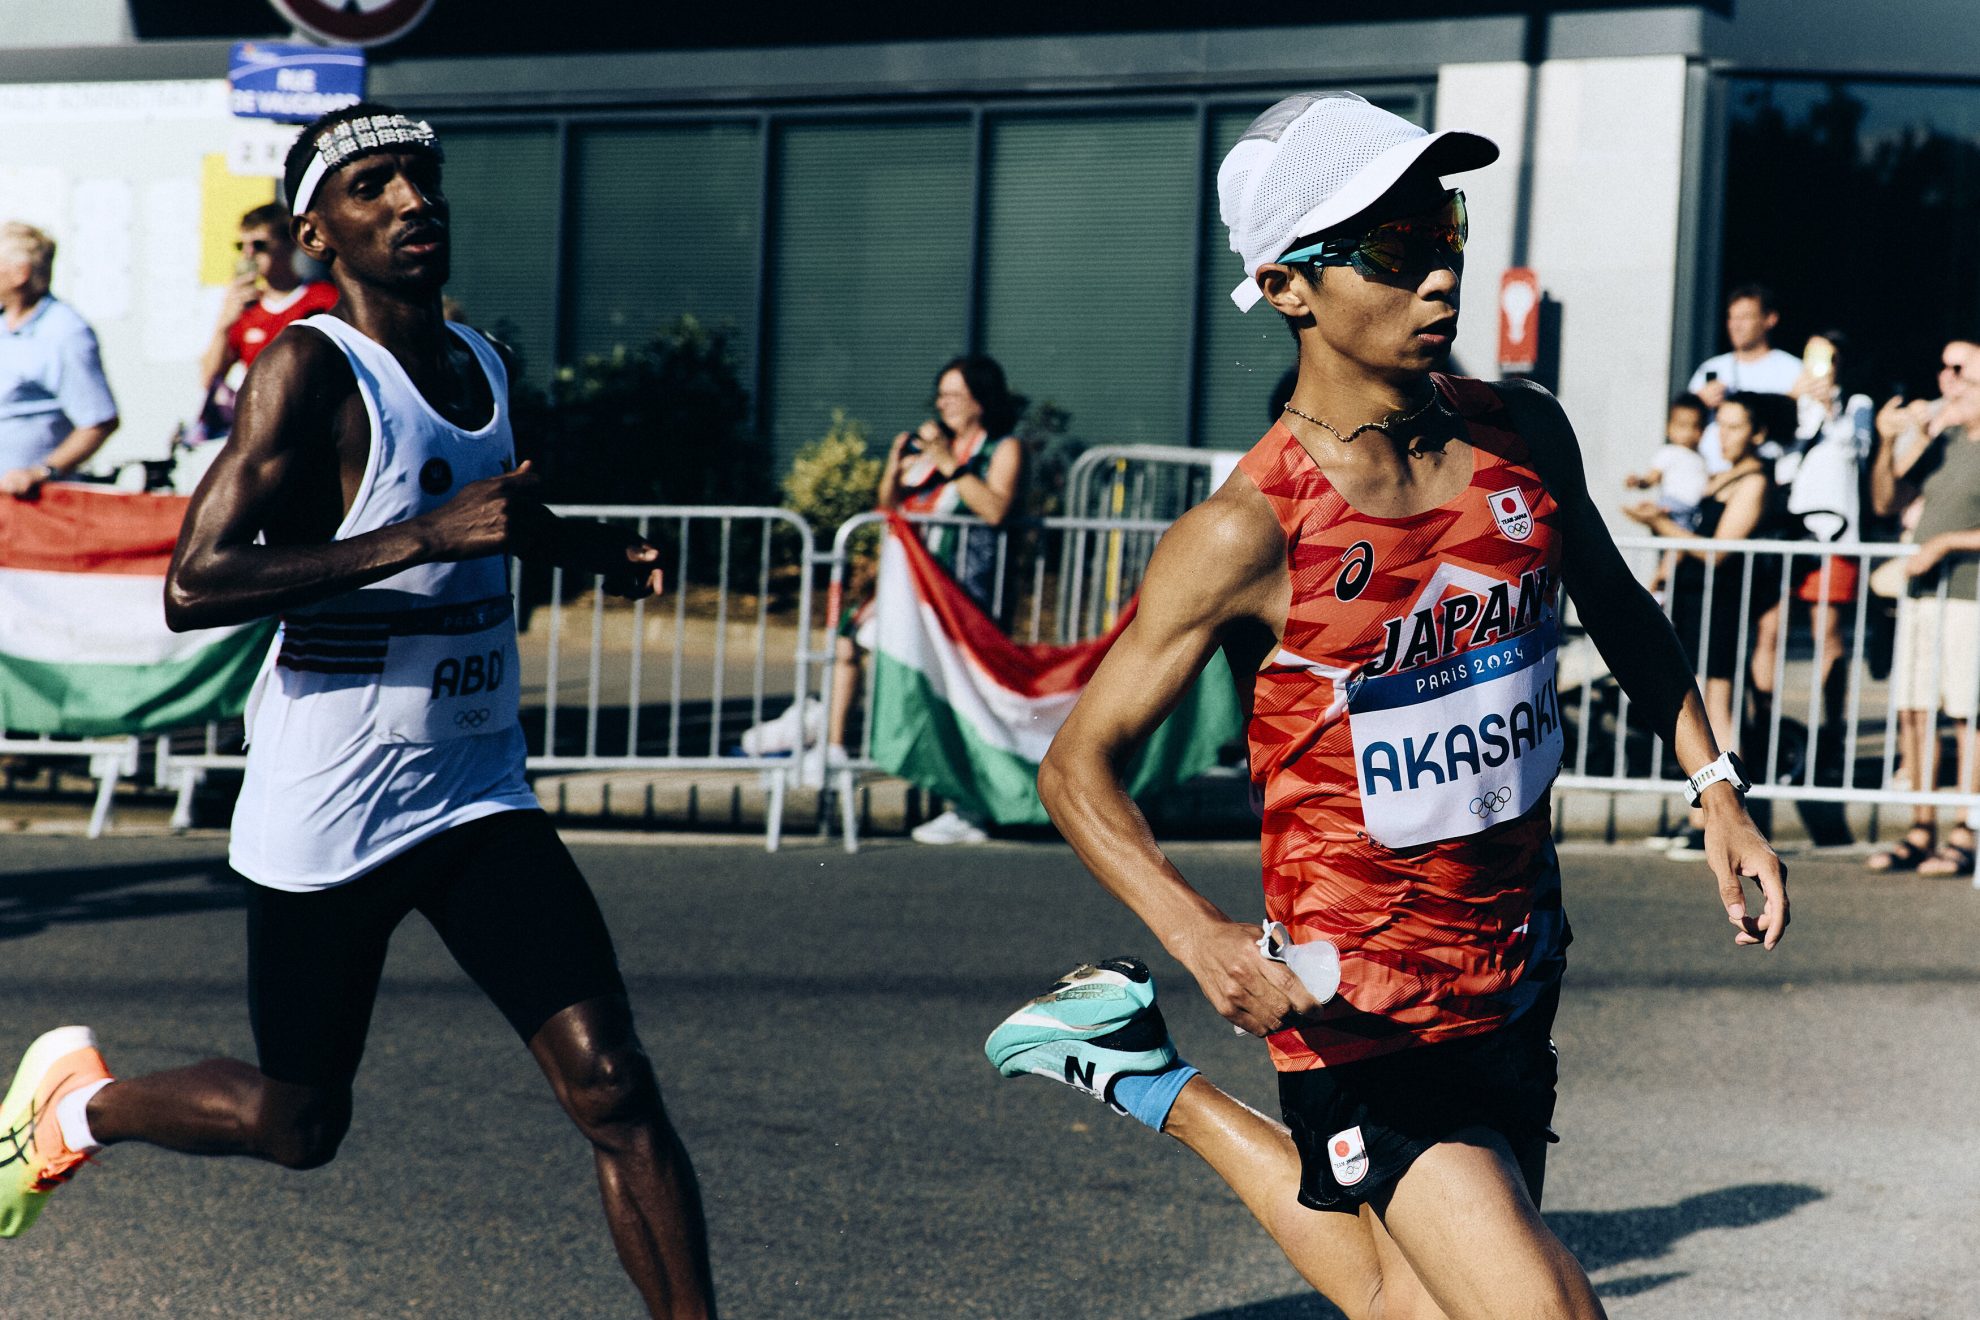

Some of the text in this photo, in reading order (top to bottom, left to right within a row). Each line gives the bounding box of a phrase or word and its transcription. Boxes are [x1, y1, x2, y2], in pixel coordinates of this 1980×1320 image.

[1501, 517, 1514, 526] TEAM
[1362, 566, 1548, 677] JAPAN
[1473, 647, 1525, 675] 2024
[1361, 676, 1558, 796] AKASAKI
